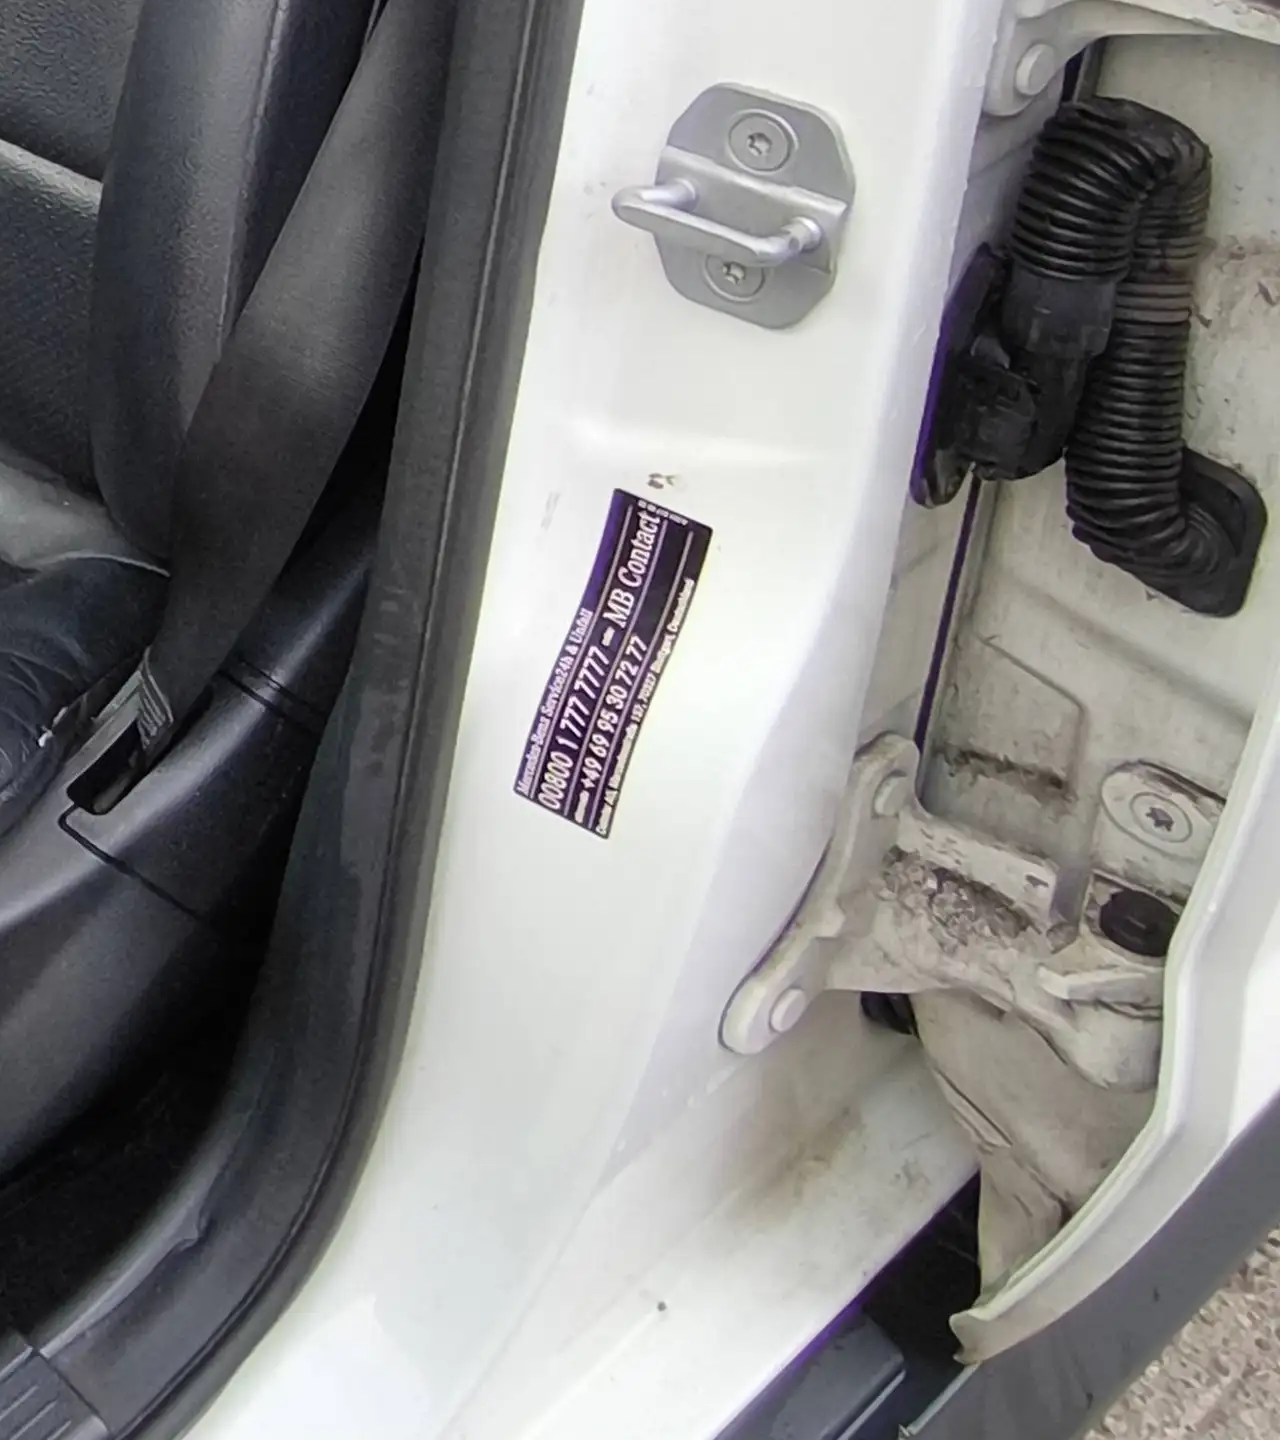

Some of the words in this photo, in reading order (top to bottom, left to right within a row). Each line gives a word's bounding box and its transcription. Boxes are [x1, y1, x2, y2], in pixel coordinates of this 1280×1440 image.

[617, 512, 660, 586] Contact
[602, 588, 634, 628] MB
[625, 635, 646, 661] 77
[573, 645, 609, 698] 7777
[614, 660, 638, 685] 72
[605, 684, 627, 709] 30
[559, 695, 589, 736] 777
[597, 708, 618, 732] 95
[556, 735, 578, 749] 1
[589, 733, 609, 757] 69
[538, 751, 573, 809] 00800
[581, 757, 601, 787] +49
